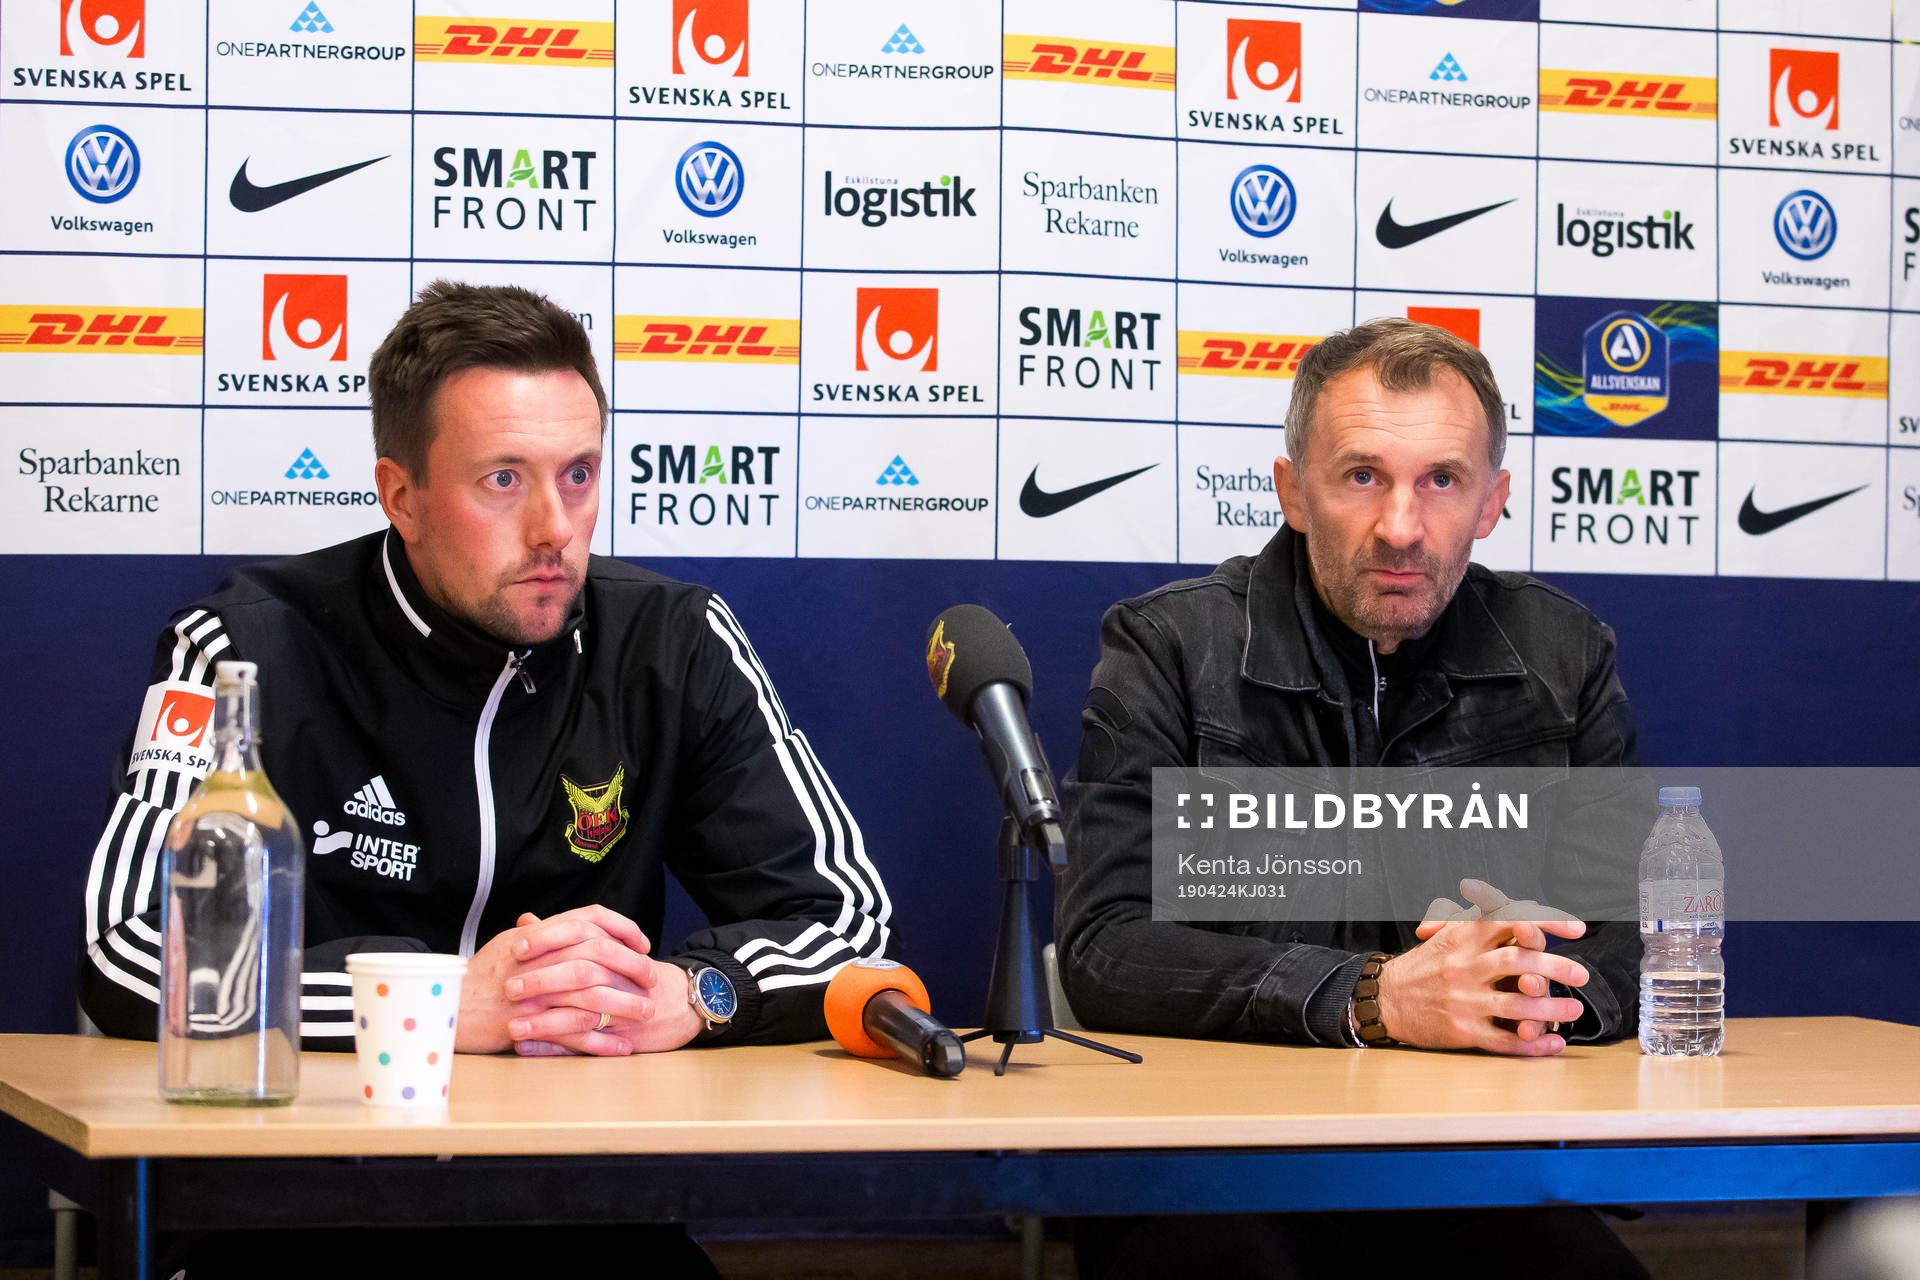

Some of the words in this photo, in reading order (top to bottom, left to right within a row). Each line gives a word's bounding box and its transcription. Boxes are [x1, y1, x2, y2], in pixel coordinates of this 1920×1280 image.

[217, 42, 405, 60] ONEPARTNERGROUP
[444, 26, 585, 58] DHL
[812, 63, 994, 79] ONEPARTNERGROUP
[1031, 45, 1151, 80] DHL
[14, 68, 126, 89] SVENSKA
[136, 72, 192, 91] SPEL
[629, 86, 732, 107] SVENSKA
[741, 90, 791, 109] SPEL
[1365, 88, 1531, 109] ONEPARTNERGROUP
[1566, 79, 1690, 110] DHL
[1189, 110, 1284, 132] SVENSKA
[1293, 116, 1343, 135] SPEL
[1730, 138, 1824, 158] SVENSKA
[1832, 143, 1879, 161] SPEL
[434, 147, 596, 190] SMART
[845, 176, 898, 185] Eskilstuna
[825, 171, 976, 227] logistik
[1024, 172, 1158, 204] Sparbanken
[51, 216, 153, 236] Volkswagen
[434, 196, 596, 231] FRONT
[1046, 208, 1139, 238] Rekarne
[663, 229, 756, 249] Volkswagen
[1557, 203, 1695, 257] logistik
[1219, 249, 1308, 268] Volkswagen
[1763, 272, 1850, 290] Volkswagen
[27, 314, 174, 346] DHL
[642, 325, 773, 355] DHL
[1019, 307, 1161, 350] SMART
[218, 373, 329, 392] SVENSKA
[338, 375, 366, 393] SP
[1019, 354, 1161, 391] FRONT
[1591, 375, 1660, 391] ALLSVENSKAN
[1746, 360, 1864, 390] DHL
[813, 384, 919, 402] SVENSKA
[929, 385, 984, 402] SPEL
[19, 448, 180, 480] Sparbanken
[631, 444, 780, 485] SMART
[1196, 464, 1275, 498] Sparba
[1552, 467, 1700, 506] SMART
[44, 486, 158, 512] Rekarne
[211, 490, 378, 505] ONEPARTNERGRO
[631, 493, 779, 526] FRONT
[805, 496, 988, 511] ONEPARTNERGROUP
[1216, 501, 1283, 527] Rekar
[1551, 512, 1699, 545] FRONT
[131, 748, 182, 765] SVENSKA
[186, 755, 211, 772] SP
[343, 800, 406, 826] adidas
[355, 834, 418, 863] INTER
[350, 851, 416, 881] SPORT
